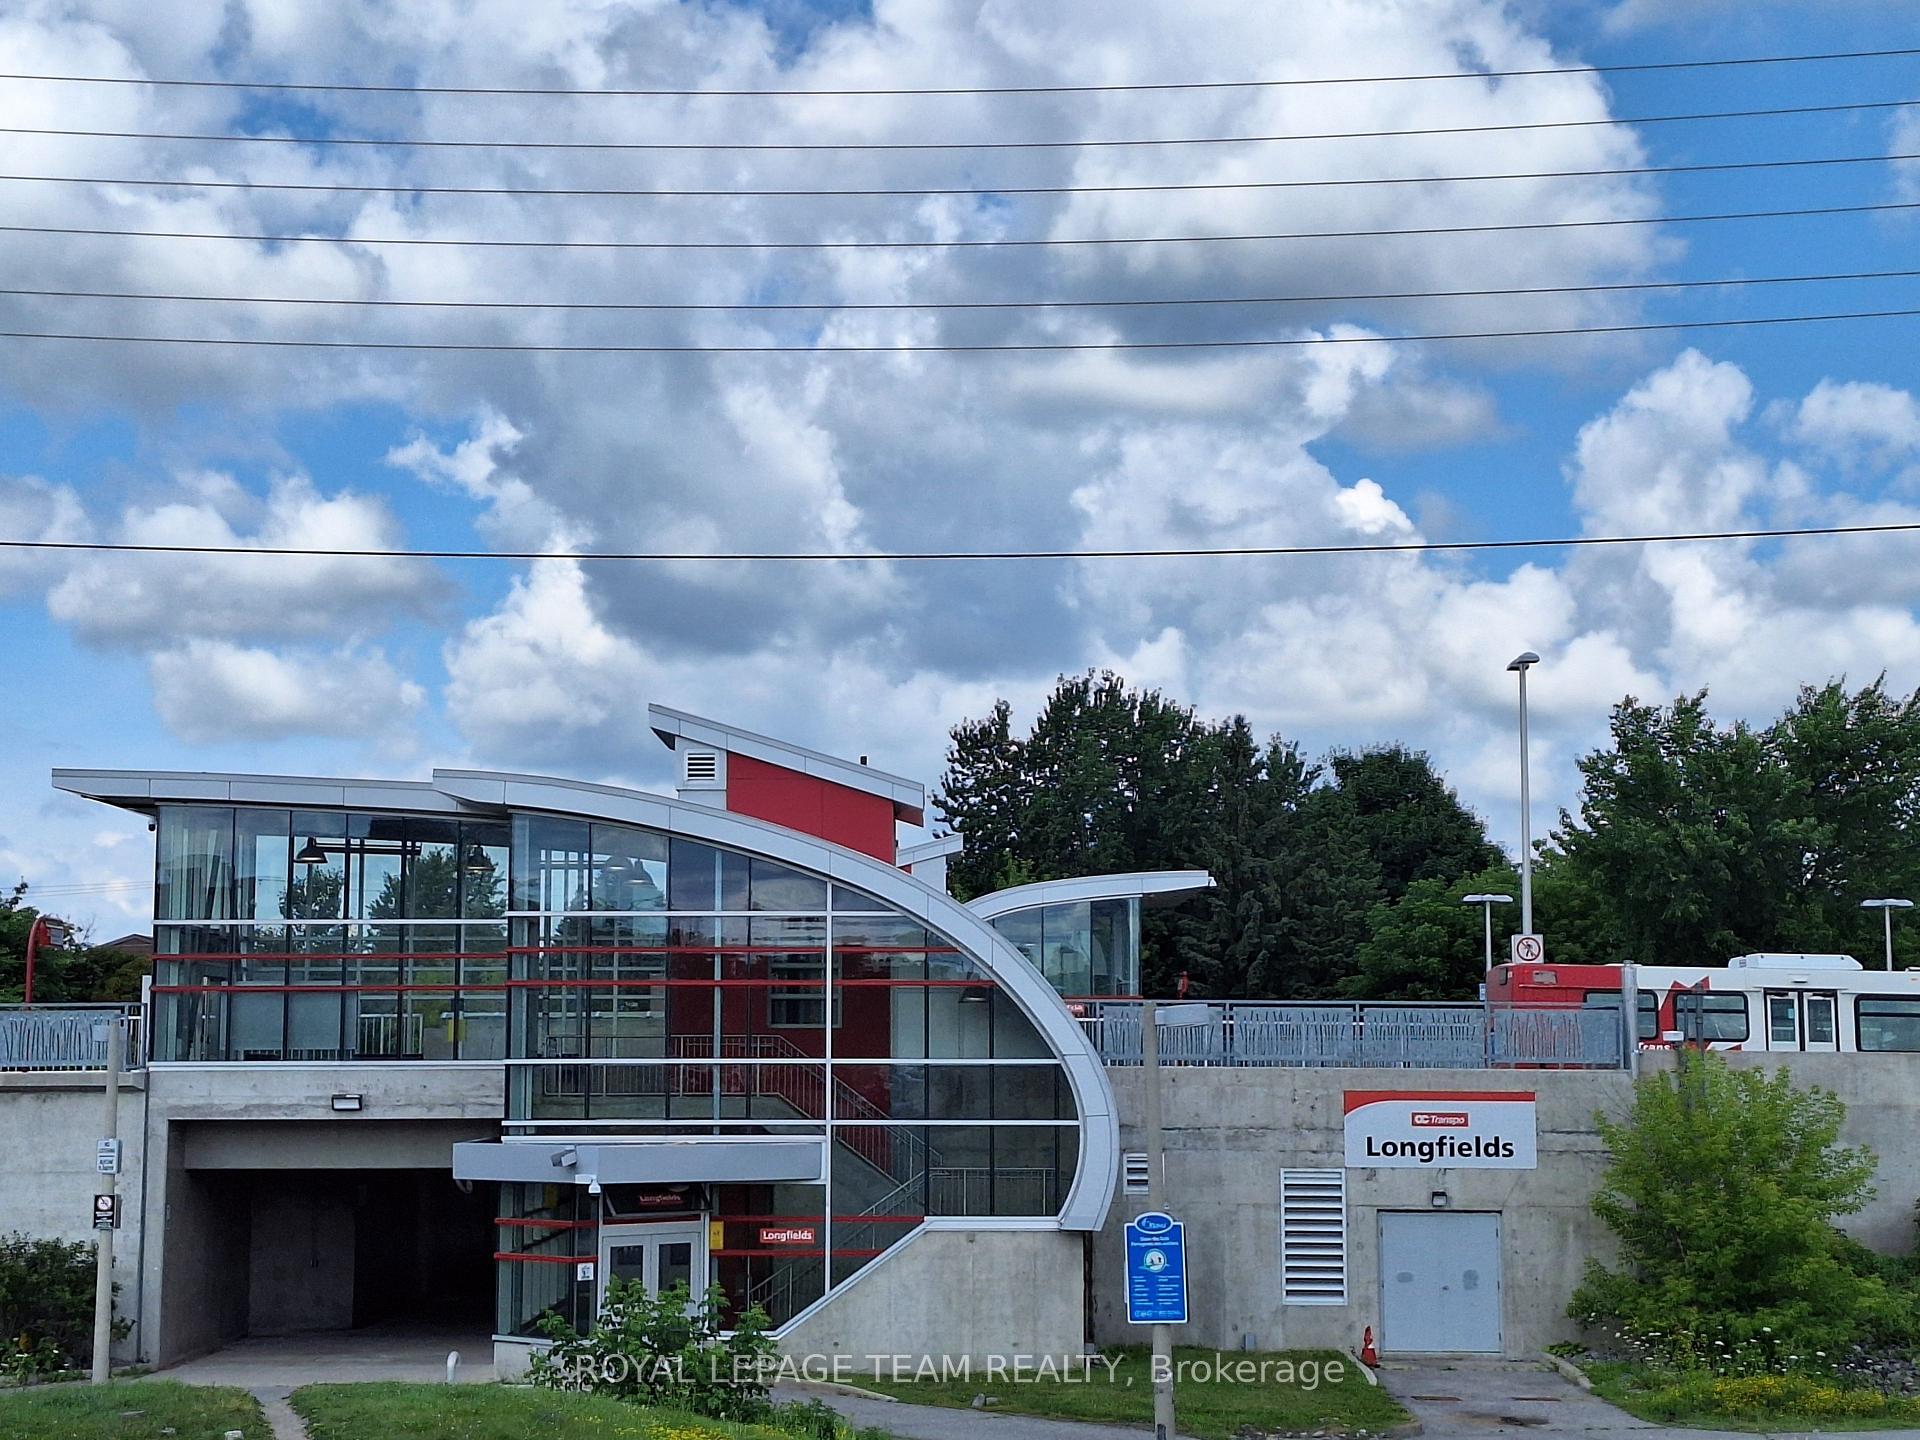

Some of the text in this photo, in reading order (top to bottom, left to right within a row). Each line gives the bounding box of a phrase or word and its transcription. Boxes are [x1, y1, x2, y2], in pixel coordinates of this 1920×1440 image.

[1430, 1114, 1465, 1126] Transpo
[1366, 1135, 1515, 1163] Longfields
[762, 1230, 813, 1242] Longfields
